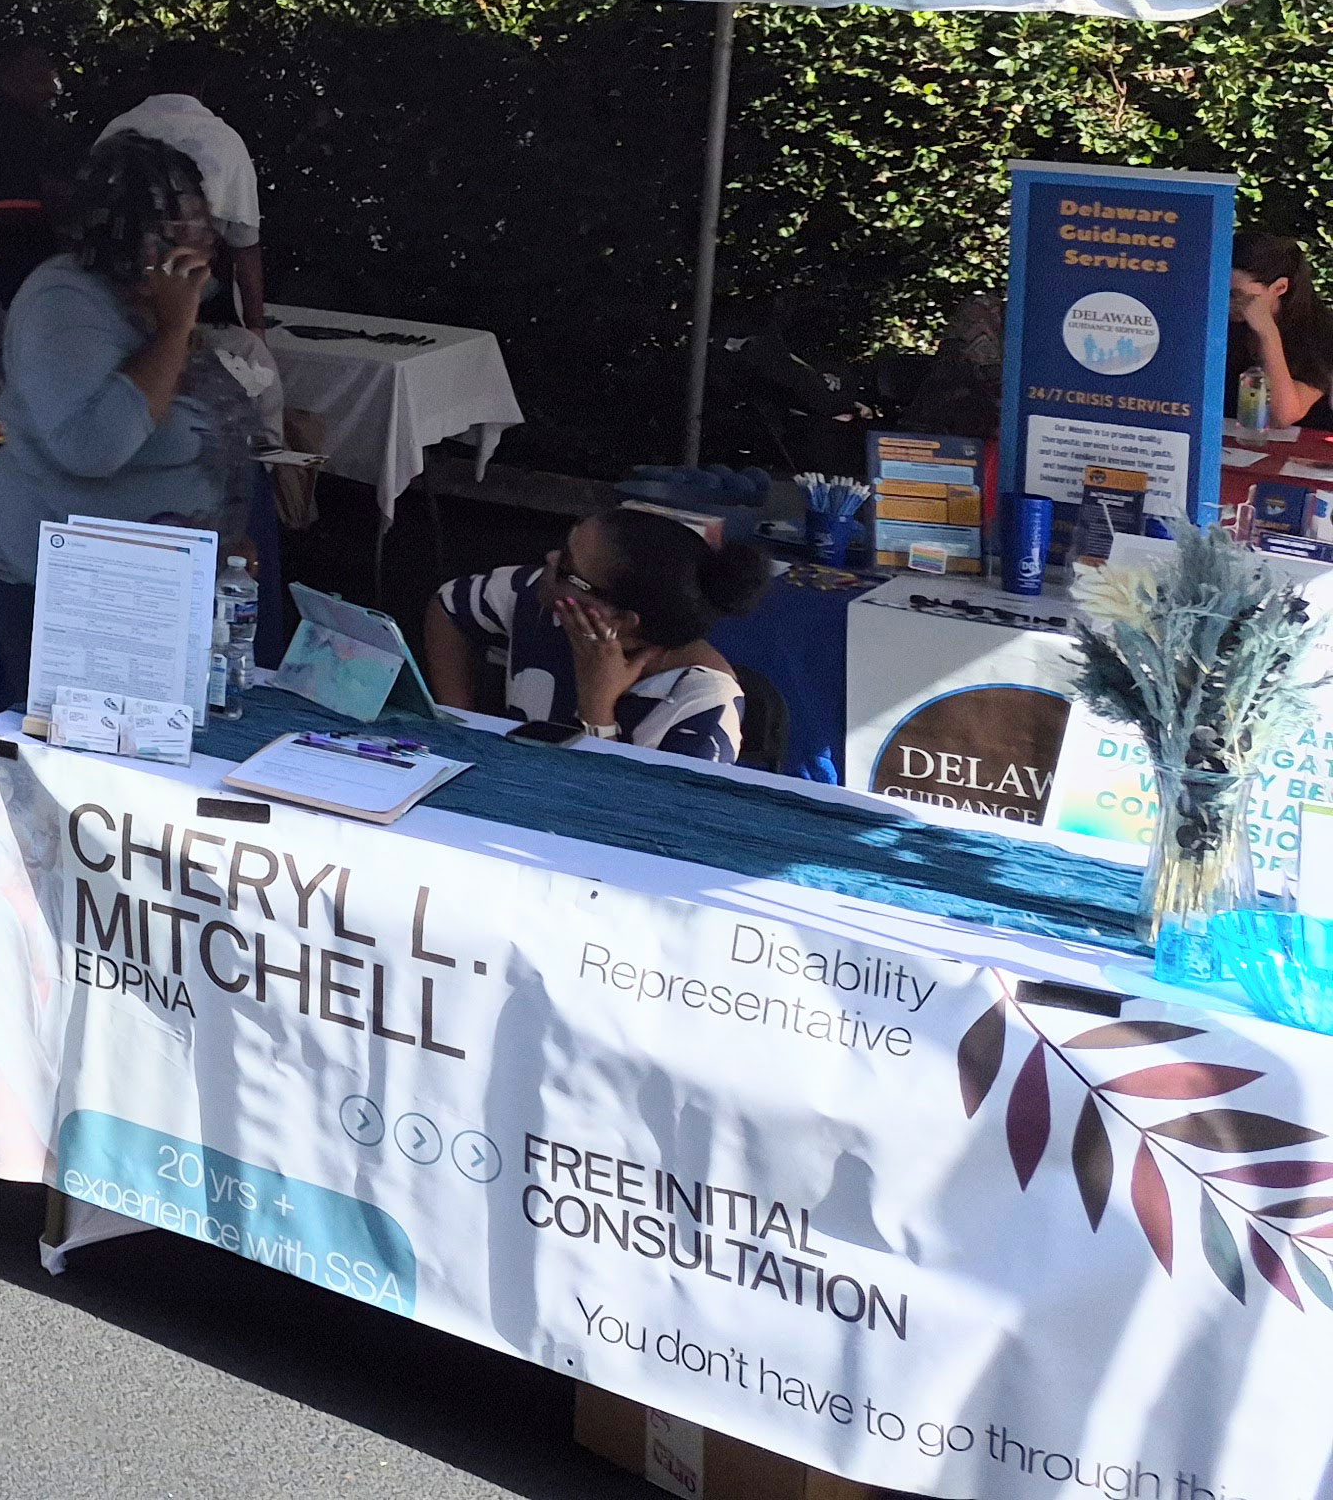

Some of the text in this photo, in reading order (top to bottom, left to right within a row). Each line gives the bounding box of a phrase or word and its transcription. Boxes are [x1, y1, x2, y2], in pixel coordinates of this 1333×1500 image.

[1059, 224, 1176, 248] Guidance
[1060, 200, 1179, 224] Delaware
[1063, 249, 1169, 273] Services
[1068, 321, 1155, 337] GUIDANCE SERVICES
[1072, 309, 1153, 327] DELAWARE
[1028, 386, 1191, 417] 24/7 CRISIS SERVICES
[898, 745, 1054, 801] DELAW
[68, 803, 487, 975] CHERYL L.
[75, 877, 466, 1060] MITCHELL
[75, 948, 196, 1019] EDPNA
[580, 942, 913, 1057] Representative
[731, 923, 938, 1013] Disability
[157, 1144, 295, 1217] 20 yrs +
[524, 1132, 827, 1259] FREE INITIAL
[63, 1168, 406, 1314] experience with SSA
[521, 1183, 908, 1341] CONSULTATION
[575, 1297, 647, 1354] You
[656, 1328, 749, 1388] don't
[758, 1357, 854, 1425] have
[863, 1396, 906, 1441] to
[917, 1421, 975, 1457] go
[984, 1423, 1161, 1500] through
